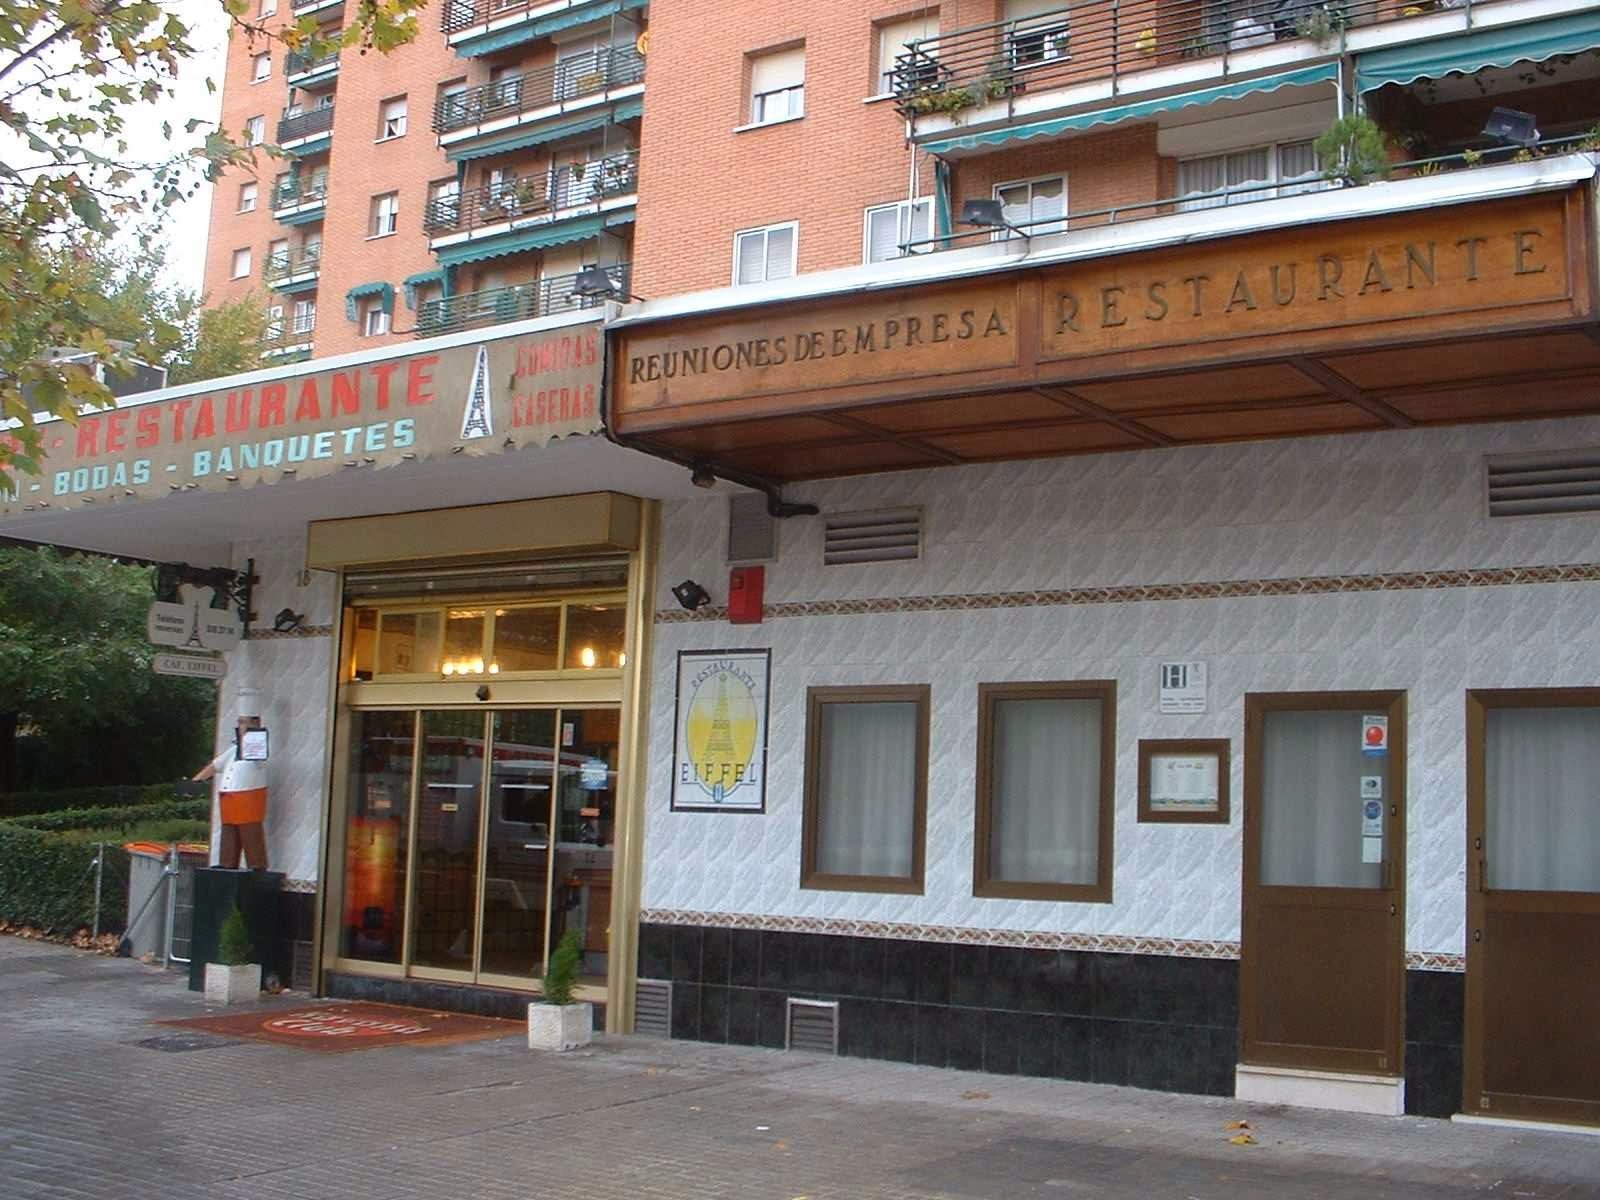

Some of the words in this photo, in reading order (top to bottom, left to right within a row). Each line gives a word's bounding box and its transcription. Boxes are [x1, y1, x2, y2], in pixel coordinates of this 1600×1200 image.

[1054, 227, 1548, 335] RESTAURANTE
[516, 332, 598, 378] COMIDAS
[630, 336, 786, 385] REUNIONES
[793, 331, 826, 363] DE
[830, 307, 1008, 359] EMPRESA
[75, 355, 441, 459] RESTAURANTE
[511, 384, 596, 428] CASERAS
[53, 459, 150, 496] BODAS
[192, 417, 417, 478] BANQUETES
[681, 762, 758, 783] EIFFEL
